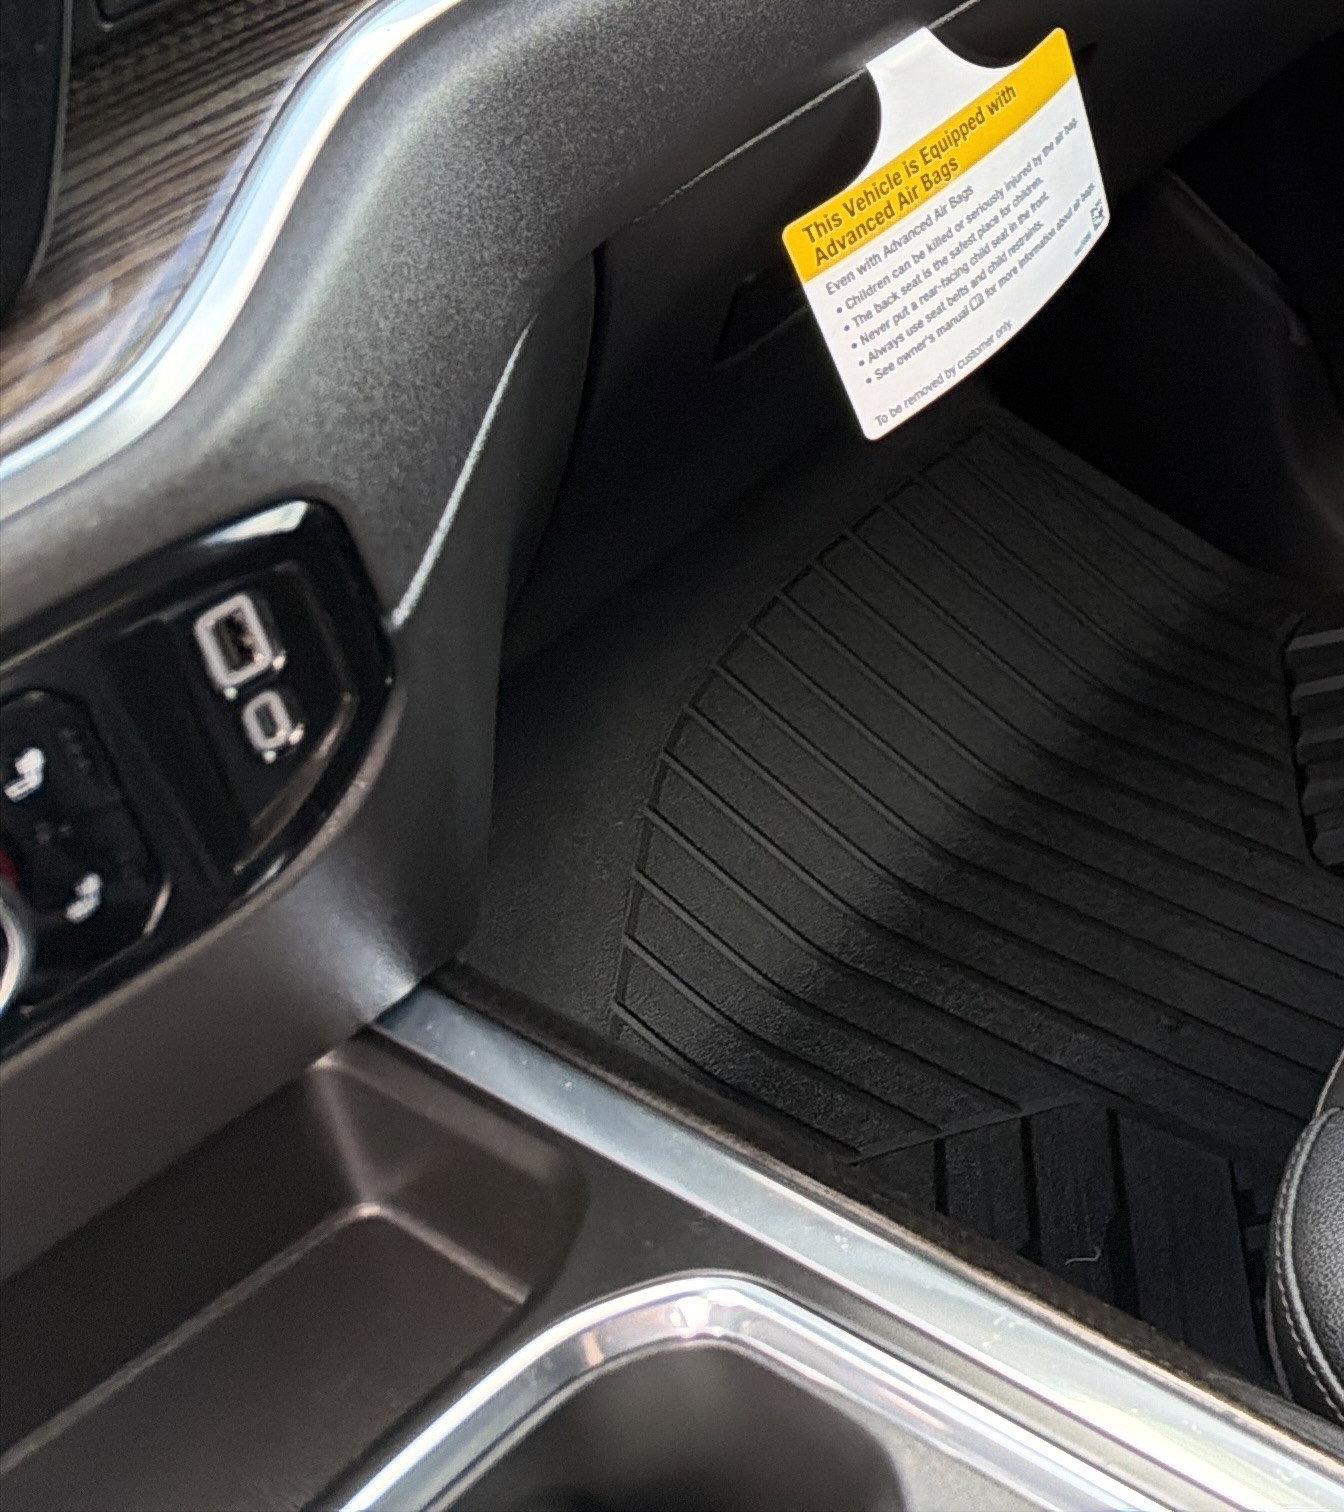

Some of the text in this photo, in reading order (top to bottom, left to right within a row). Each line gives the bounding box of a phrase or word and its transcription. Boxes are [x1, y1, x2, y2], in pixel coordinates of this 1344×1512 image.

[802, 85, 1016, 243] This Vehicle is Equipped with
[815, 157, 959, 266] Advanced Air Bags
[845, 275, 891, 309] Children
[892, 261, 911, 278] can
[911, 250, 925, 264] be
[926, 227, 953, 253] killed
[954, 219, 964, 232] or
[966, 188, 1004, 224] seriously
[1004, 161, 1032, 191] injured
[1032, 154, 1042, 167] by
[1042, 141, 1054, 157] the
[1055, 131, 1063, 145] air
[825, 185, 973, 295] Even with Advanced Air Bags
[851, 310, 873, 327] The
[873, 291, 900, 313] back
[901, 274, 923, 295] seat
[922, 268, 932, 279] is
[933, 256, 948, 271] the
[949, 232, 977, 259] safest
[977, 215, 999, 240] place
[1000, 203, 1011, 218] for
[860, 319, 890, 346] Never
[892, 306, 910, 326] put
[911, 301, 918, 311] a
[919, 262, 970, 305] rear-facing
[970, 243, 991, 266] child
[991, 228, 1009, 248] seat
[1008, 222, 1018, 233] in
[1017, 210, 1030, 225] the
[874, 362, 895, 380] See
[896, 333, 935, 365] owner's
[936, 305, 969, 337] manual
[985, 283, 997, 298] for
[998, 266, 1018, 288] more
[1018, 228, 1056, 269] information
[1056, 207, 1074, 231] about
[868, 333, 905, 364] Always
[906, 319, 924, 337] use
[925, 301, 947, 323] seat
[946, 285, 969, 306] belts
[970, 268, 987, 289] and
[987, 251, 1008, 274] child
[875, 414, 888, 426] To
[888, 404, 902, 418] be
[903, 372, 944, 408] removed
[944, 365, 956, 379] by
[957, 334, 995, 369] customer
